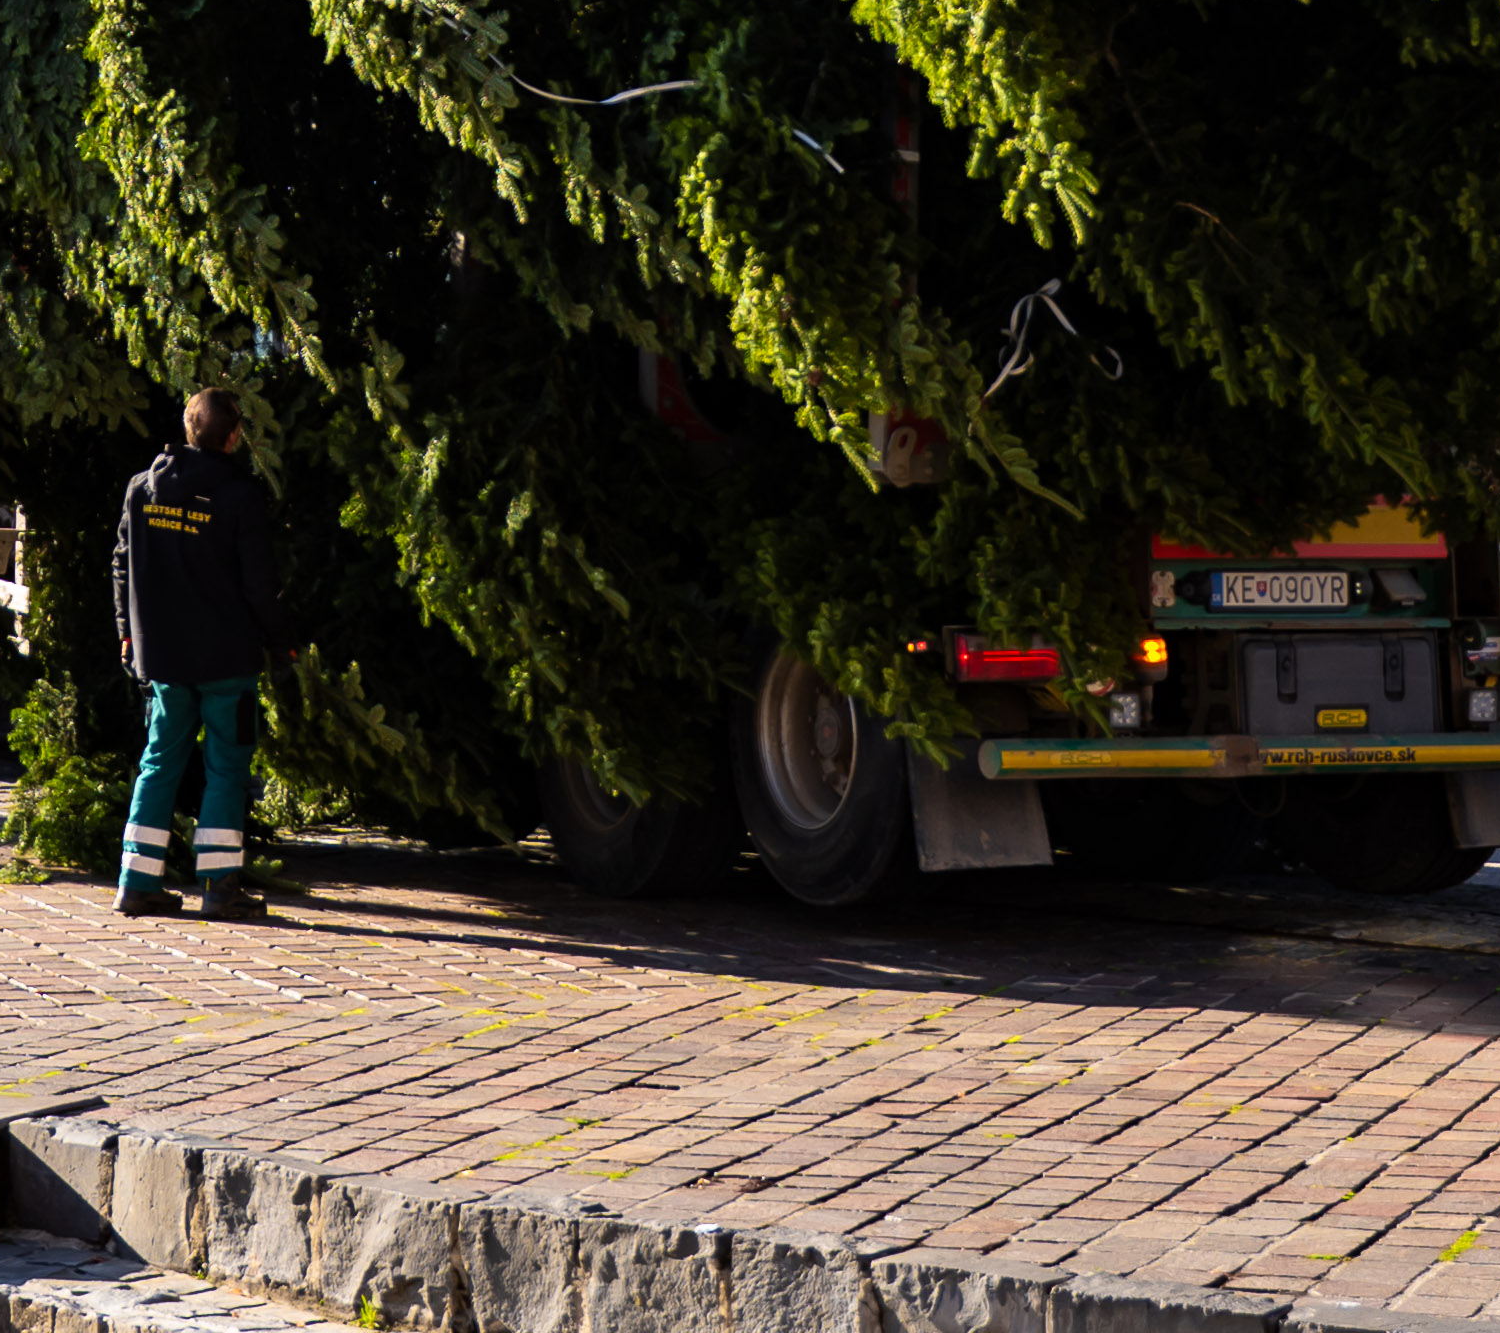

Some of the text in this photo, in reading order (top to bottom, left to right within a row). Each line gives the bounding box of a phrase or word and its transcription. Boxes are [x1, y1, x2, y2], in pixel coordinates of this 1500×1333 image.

[187, 511, 212, 523] LESY
[148, 517, 182, 531] KOŠICE
[1226, 576, 1344, 603] KE 090YR
[1322, 713, 1362, 724] RCH
